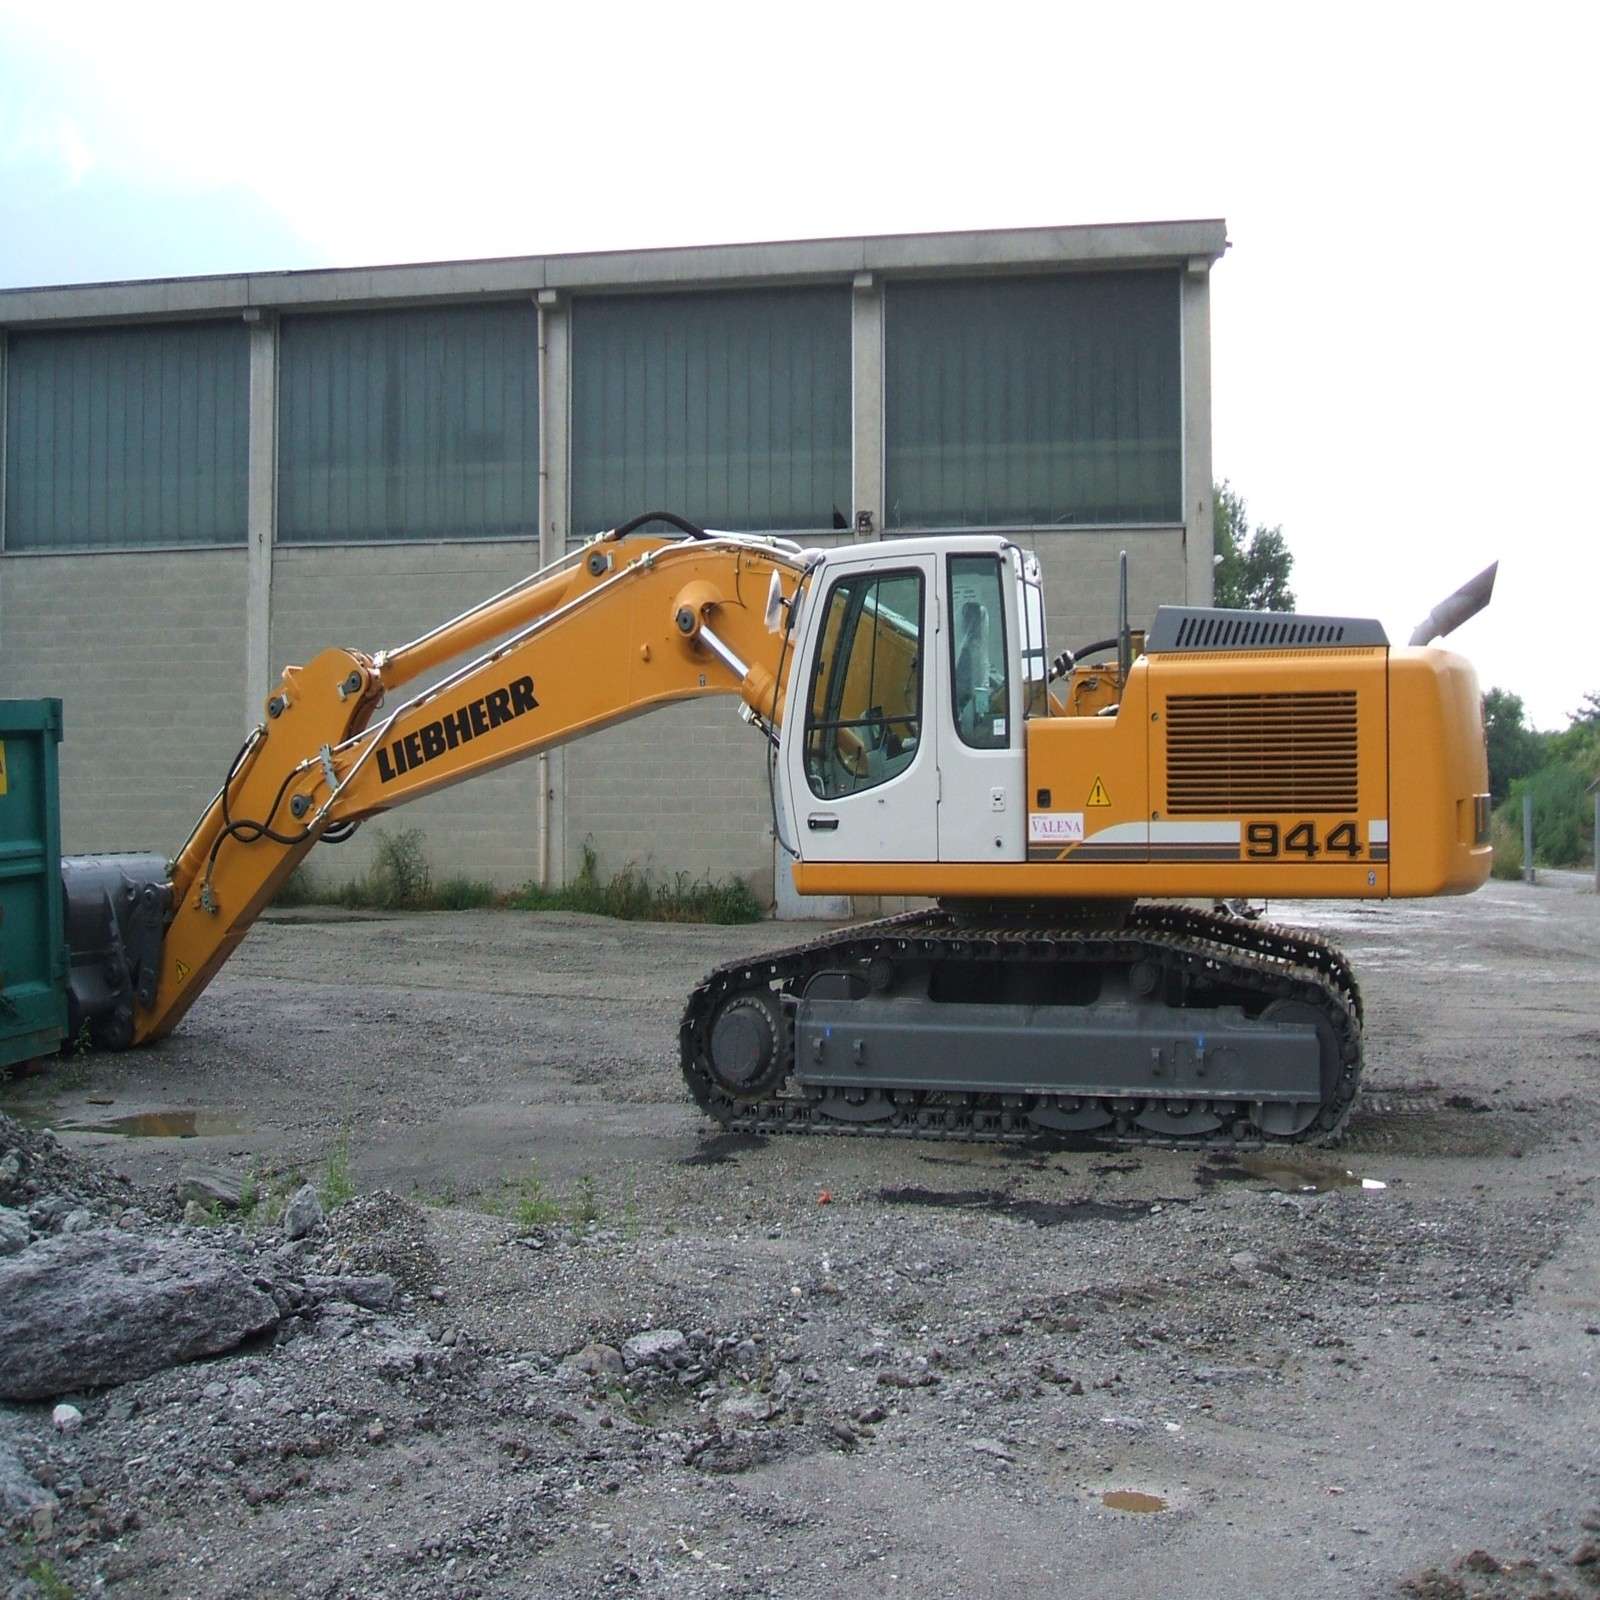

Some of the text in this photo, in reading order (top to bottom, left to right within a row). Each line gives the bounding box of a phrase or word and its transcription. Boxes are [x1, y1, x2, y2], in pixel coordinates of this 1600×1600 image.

[375, 675, 540, 784] LIEBHERR
[1031, 820, 1082, 833] VALENA
[1246, 821, 1364, 858] 944
